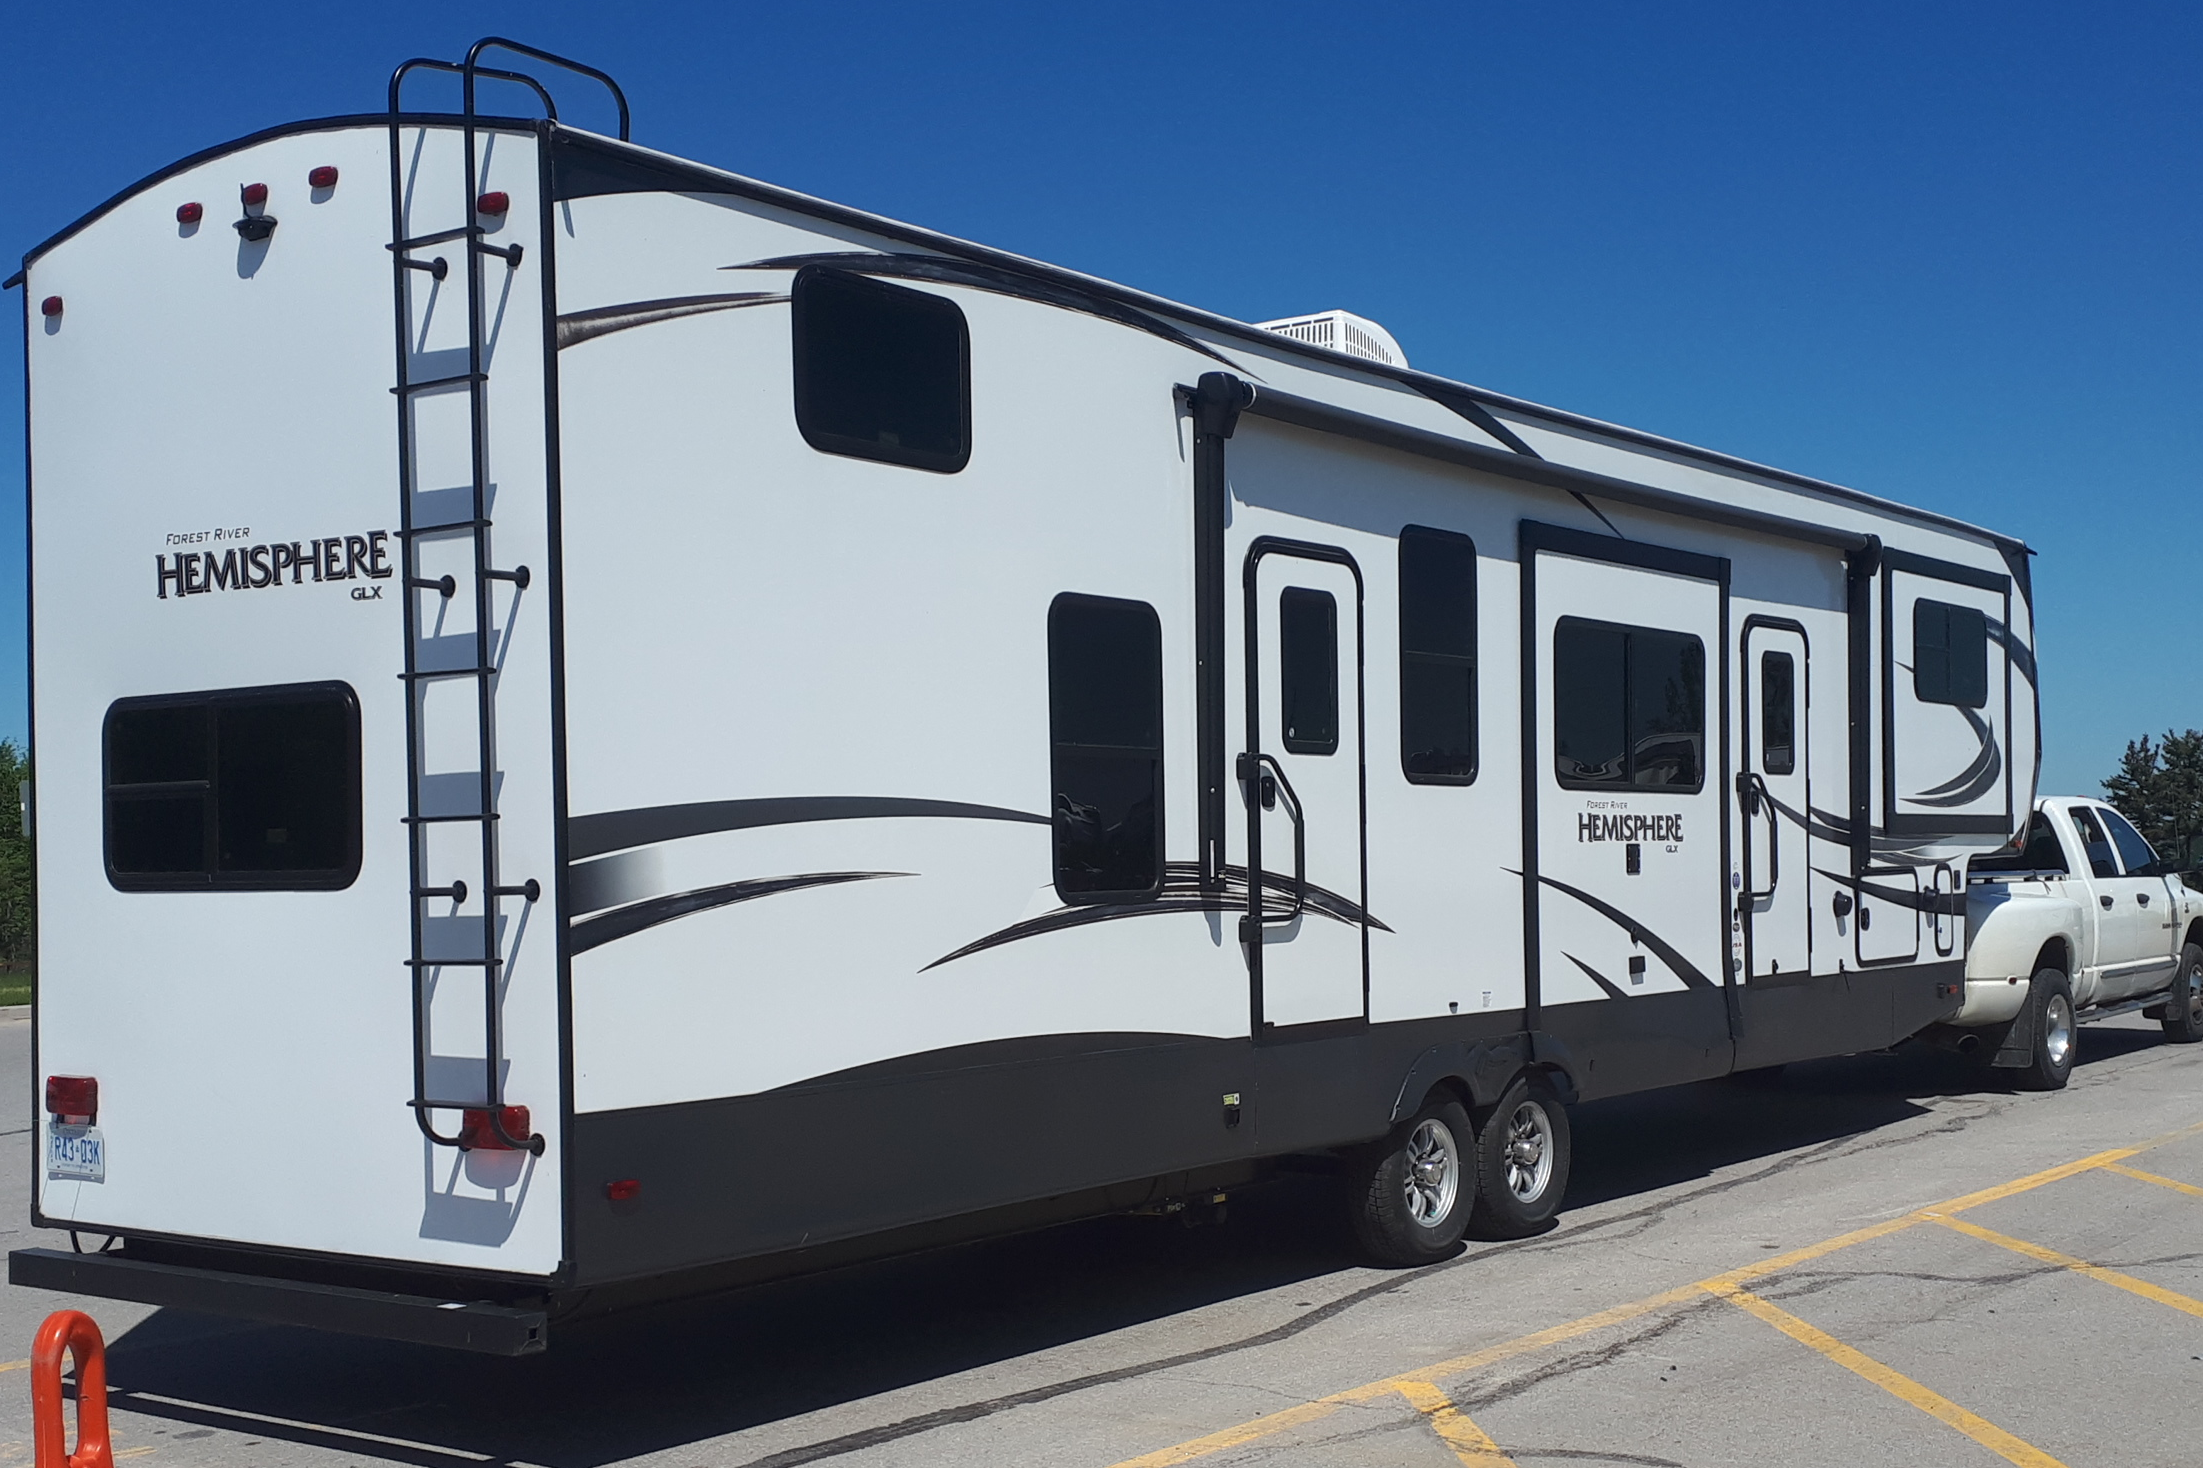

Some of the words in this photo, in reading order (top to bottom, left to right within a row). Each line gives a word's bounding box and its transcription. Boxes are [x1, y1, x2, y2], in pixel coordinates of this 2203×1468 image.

[166, 531, 211, 546] FOREST
[213, 527, 250, 541] RIVER
[155, 529, 393, 599] HEMISPHERE
[350, 585, 383, 600] GLX
[1586, 800, 1609, 809] FOREST
[1610, 801, 1628, 809] RIVER
[1577, 812, 1684, 842] HEMISPHERE
[1665, 845, 1678, 853] GLX
